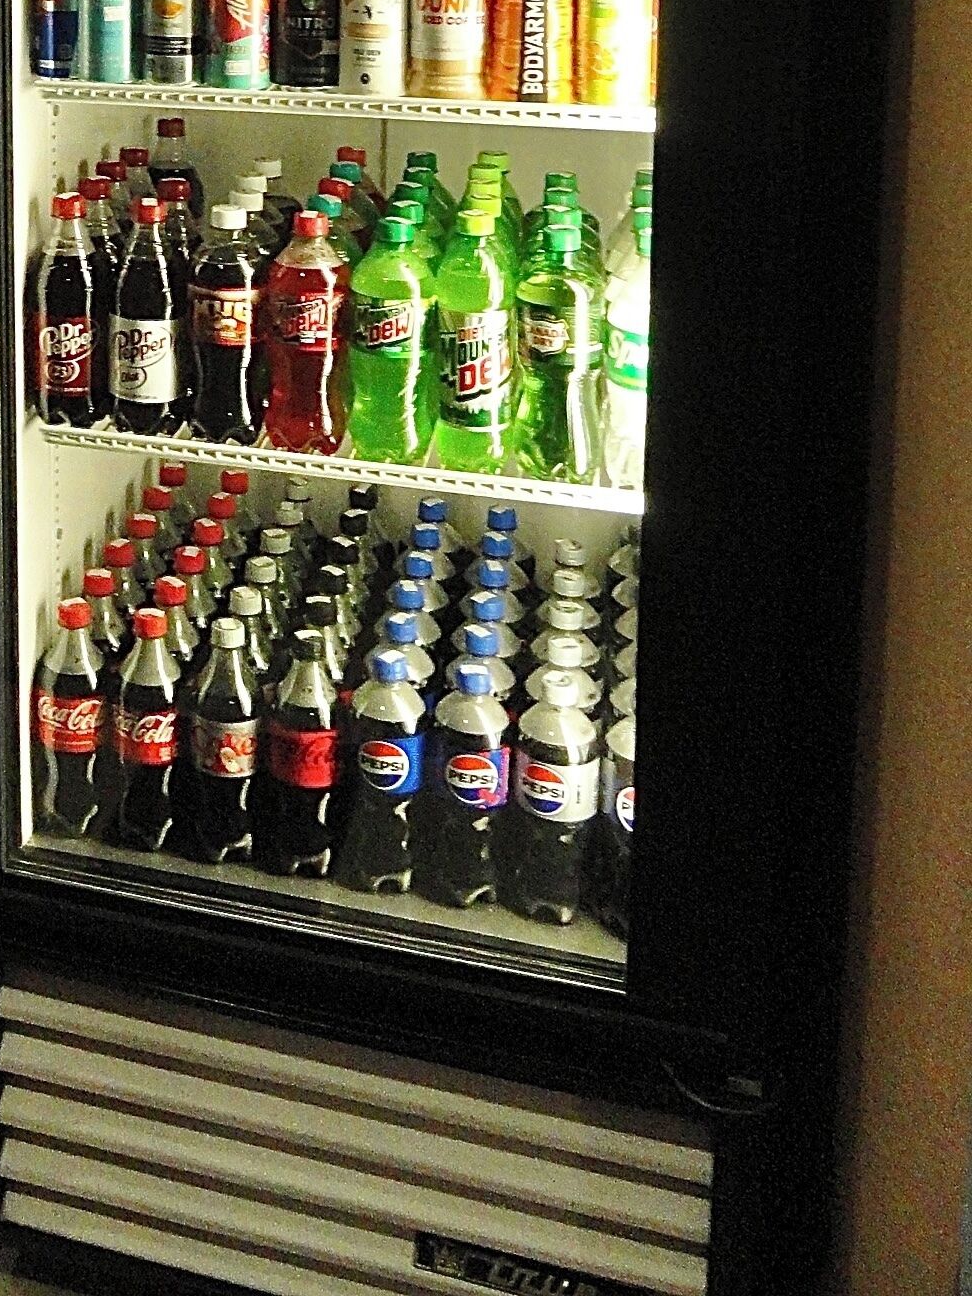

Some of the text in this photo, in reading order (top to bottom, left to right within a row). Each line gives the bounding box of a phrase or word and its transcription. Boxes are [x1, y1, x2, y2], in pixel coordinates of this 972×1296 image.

[446, 15, 486, 25] COFEE
[58, 323, 84, 342] Dr
[129, 328, 152, 346] Dr
[38, 326, 93, 358] Peppe
[114, 330, 167, 364] Pepper
[361, 756, 405, 772] PEPSI
[448, 769, 495, 785] PEPSI
[522, 777, 565, 799] PEPSI
